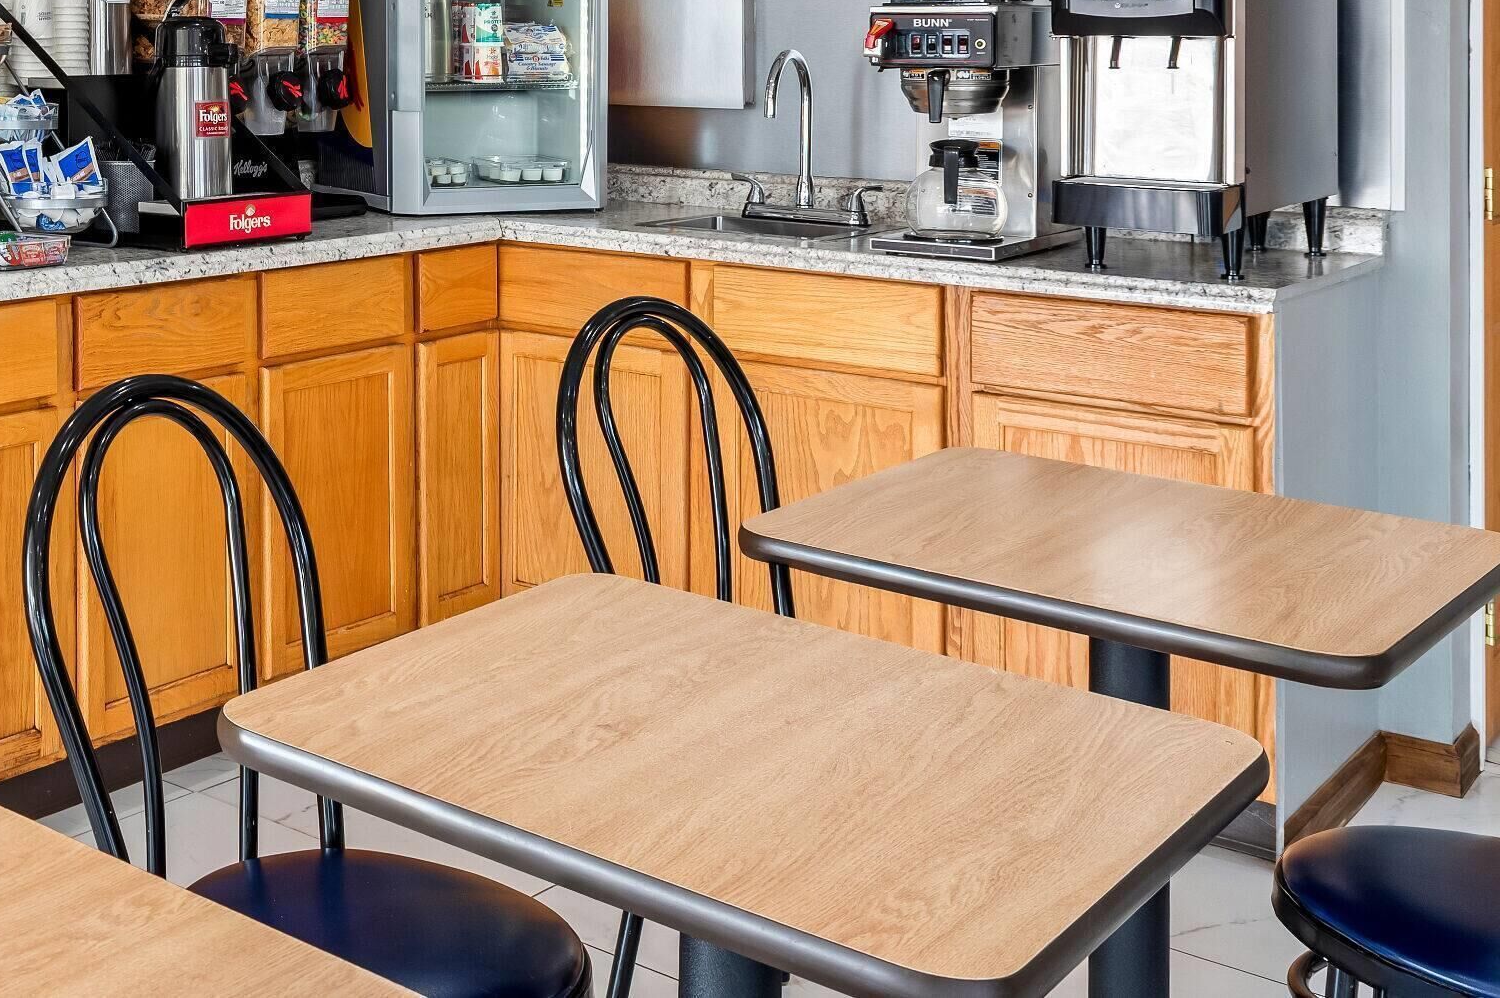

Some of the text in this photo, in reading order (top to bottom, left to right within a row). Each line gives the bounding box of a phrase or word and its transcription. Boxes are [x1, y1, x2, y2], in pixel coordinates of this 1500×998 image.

[199, 109, 228, 124] Folgers
[233, 159, 268, 178] Kellogg's
[229, 213, 271, 234] Folgers
